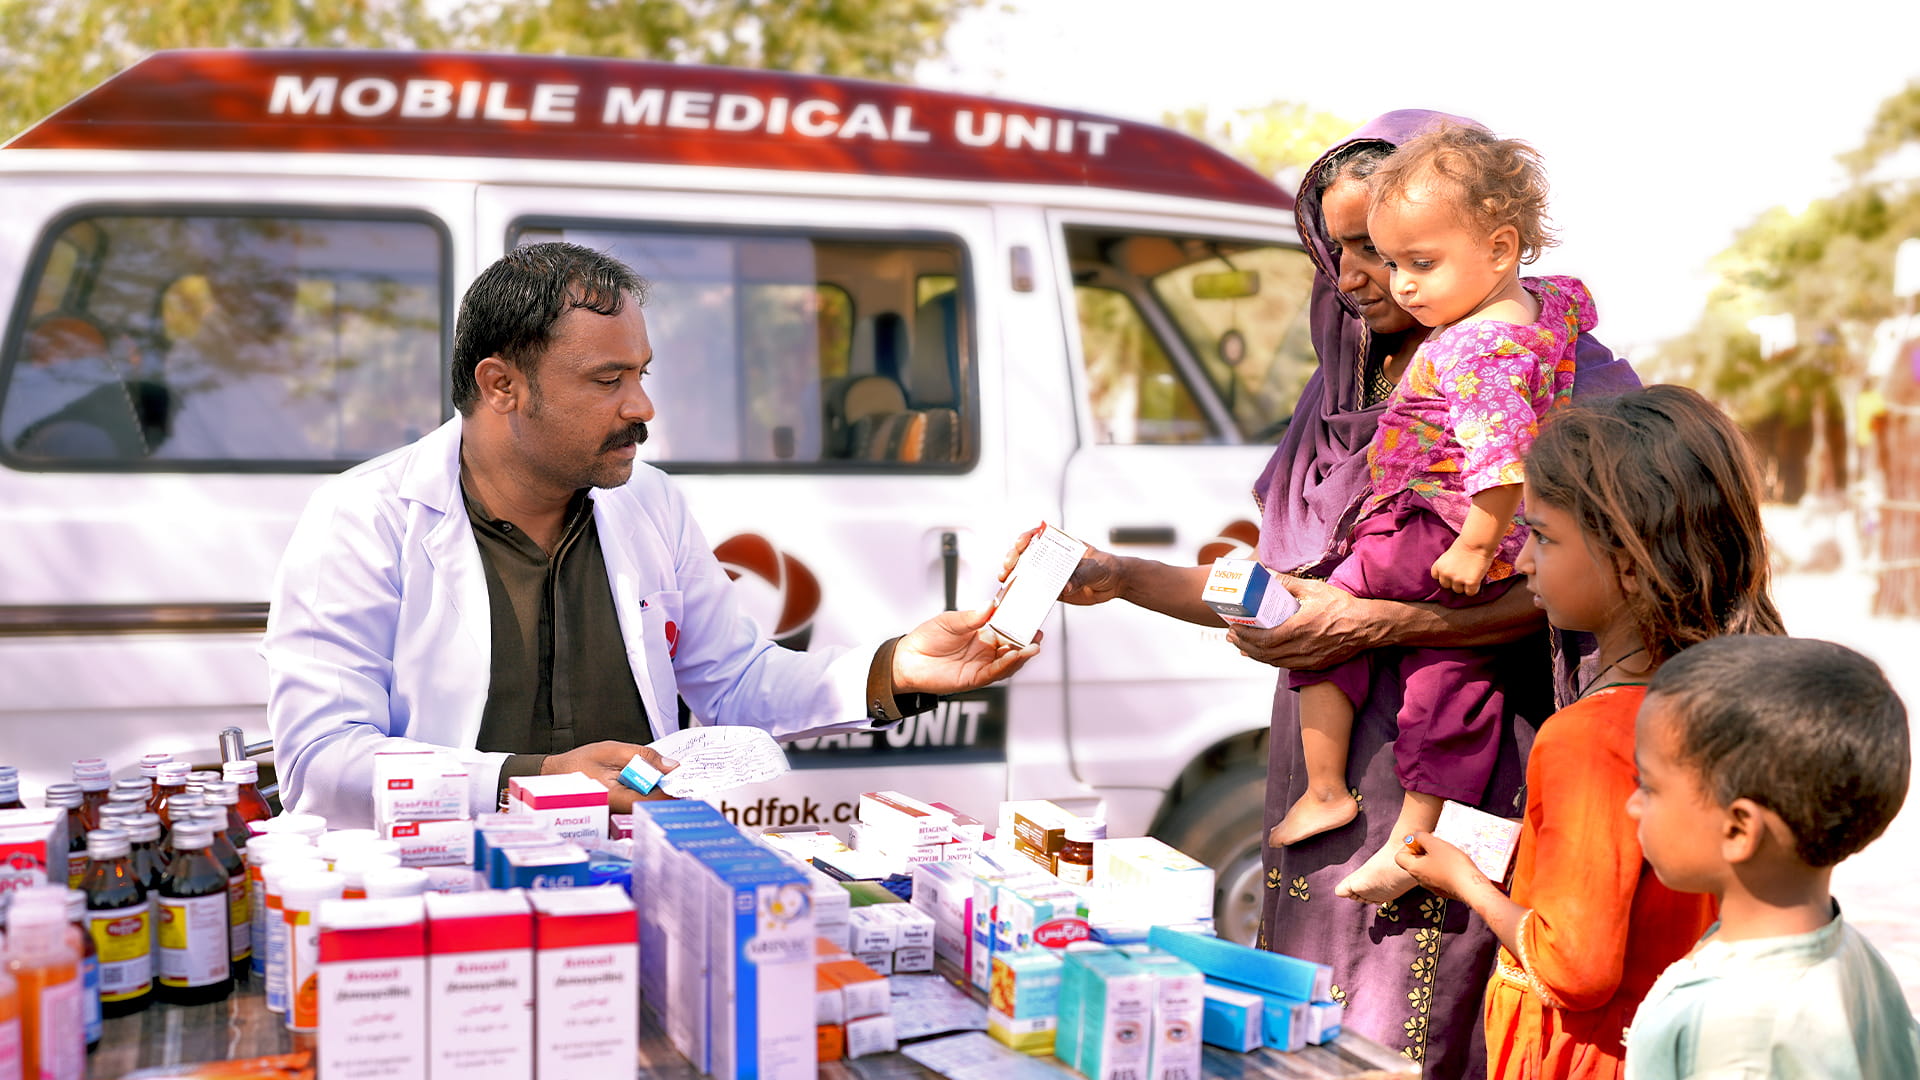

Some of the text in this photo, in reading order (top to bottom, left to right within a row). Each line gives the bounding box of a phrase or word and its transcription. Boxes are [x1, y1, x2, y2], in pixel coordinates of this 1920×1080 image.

[267, 75, 1120, 157] MOBILE MEDICAL UNIT
[1214, 570, 1243, 581] LYSOVIT
[887, 700, 990, 748] UNIT
[393, 800, 441, 809] ScabFREE
[720, 795, 860, 828] hdfpk.c
[554, 815, 591, 827] Amoxil
[400, 845, 448, 856] ScabFREE
